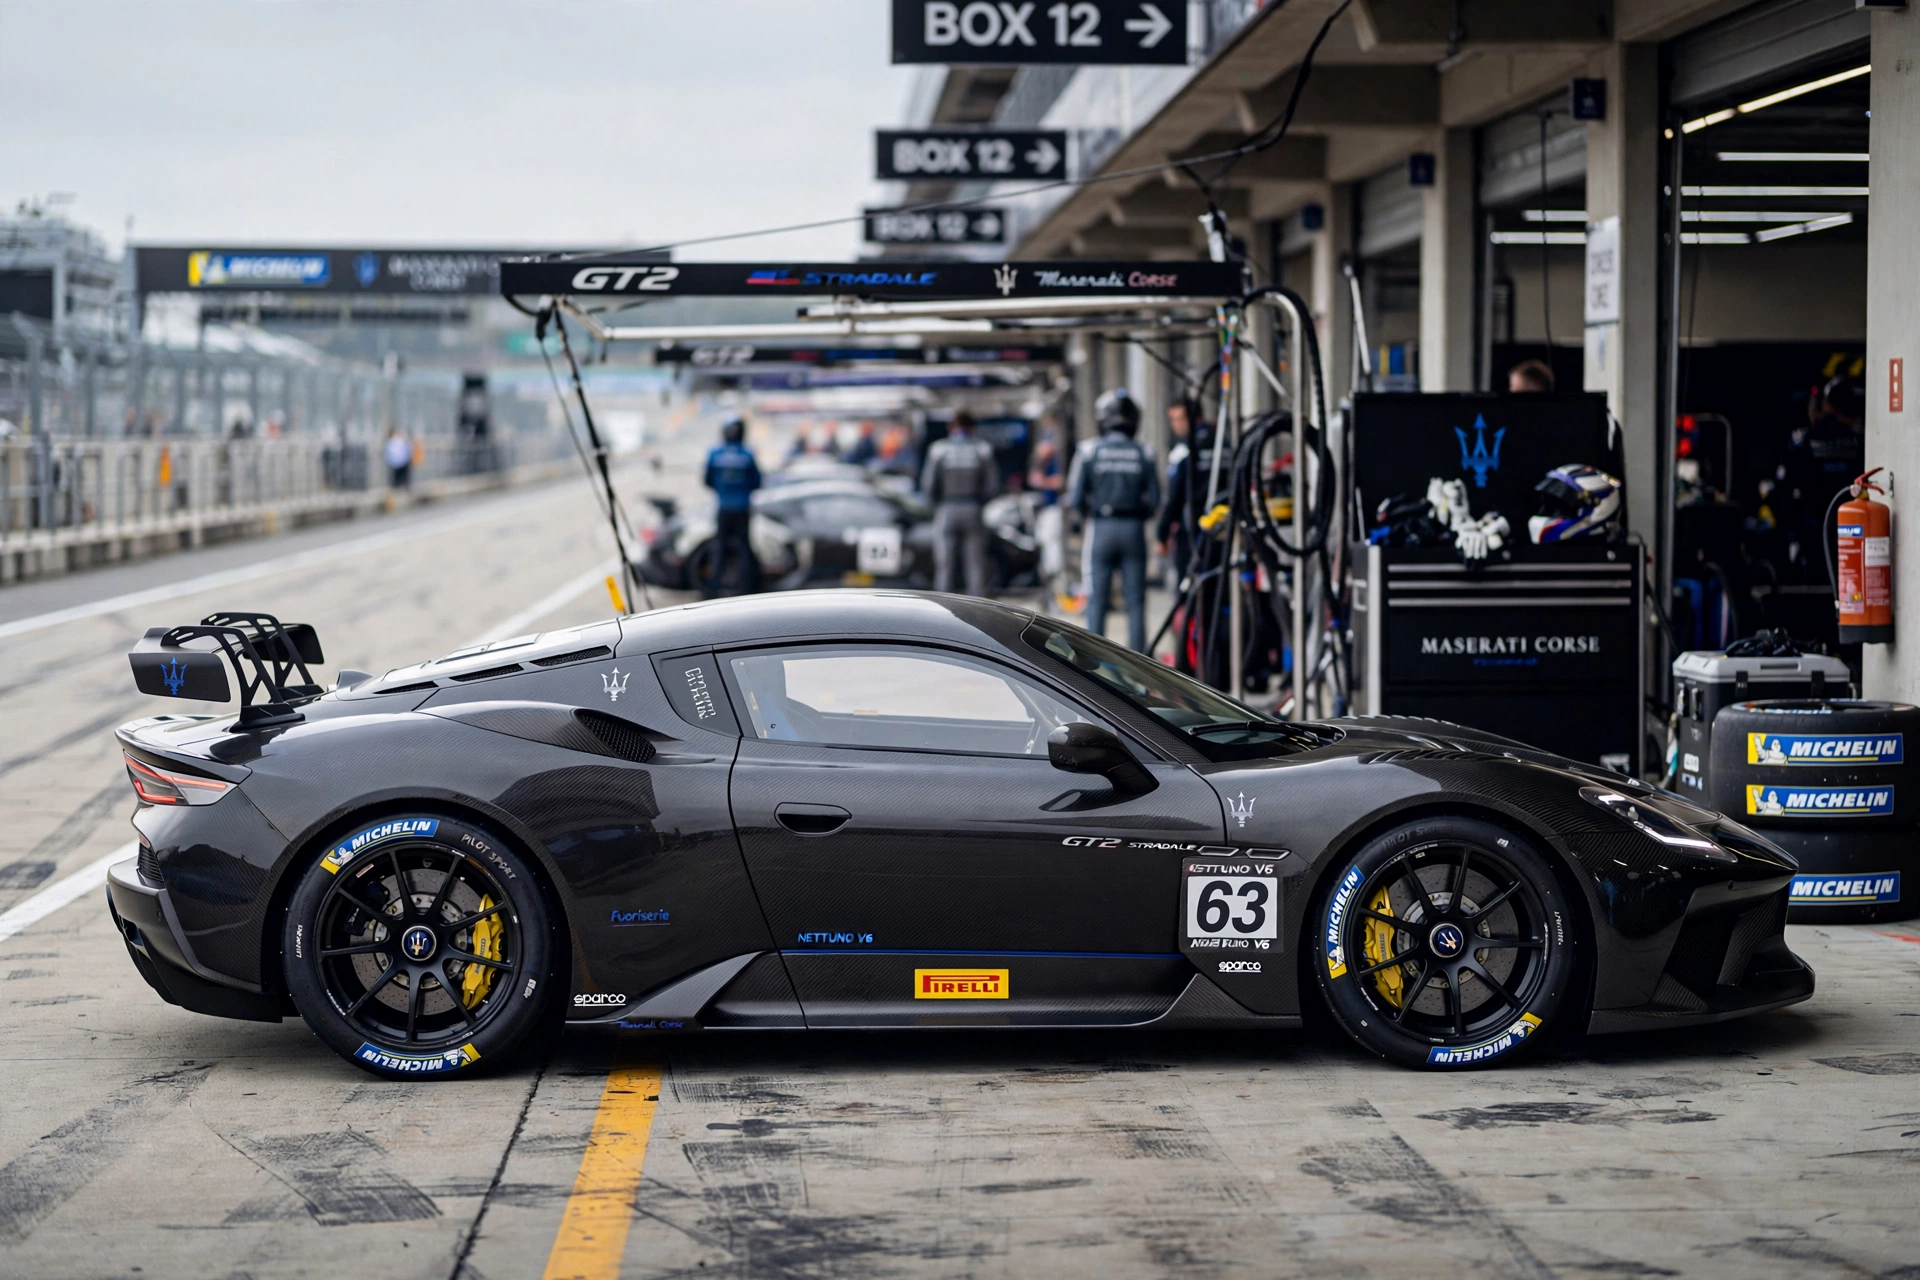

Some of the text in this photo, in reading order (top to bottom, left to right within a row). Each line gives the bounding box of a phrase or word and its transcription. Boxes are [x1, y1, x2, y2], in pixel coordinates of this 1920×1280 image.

[924, 1, 1101, 47] BOX 12
[892, 139, 1015, 174] BOX 12
[572, 267, 679, 291] GT2
[803, 272, 937, 286] STRADALE
[1034, 270, 1125, 288] Maserati
[1421, 635, 1600, 654] MASERATI CORSE
[1790, 740, 1897, 757] MICHELIN
[1786, 792, 1889, 808] MICHELIN
[351, 820, 432, 850] MICHELIN
[1061, 836, 1198, 851] GT2 STRADALE
[1255, 864, 1275, 875] V6
[1791, 878, 1894, 896] MICHELIN
[610, 908, 670, 922] Fuoriserie
[1196, 880, 1269, 934] 63
[1327, 872, 1359, 945] MICHELIN
[797, 932, 874, 943] NETTUNO V6
[1218, 961, 1262, 973] sparco
[922, 975, 1001, 993] PIRELLI
[573, 993, 627, 1007] sparco
[1434, 1034, 1513, 1063] MICHELIN
[361, 1049, 444, 1071] MICHELIN
